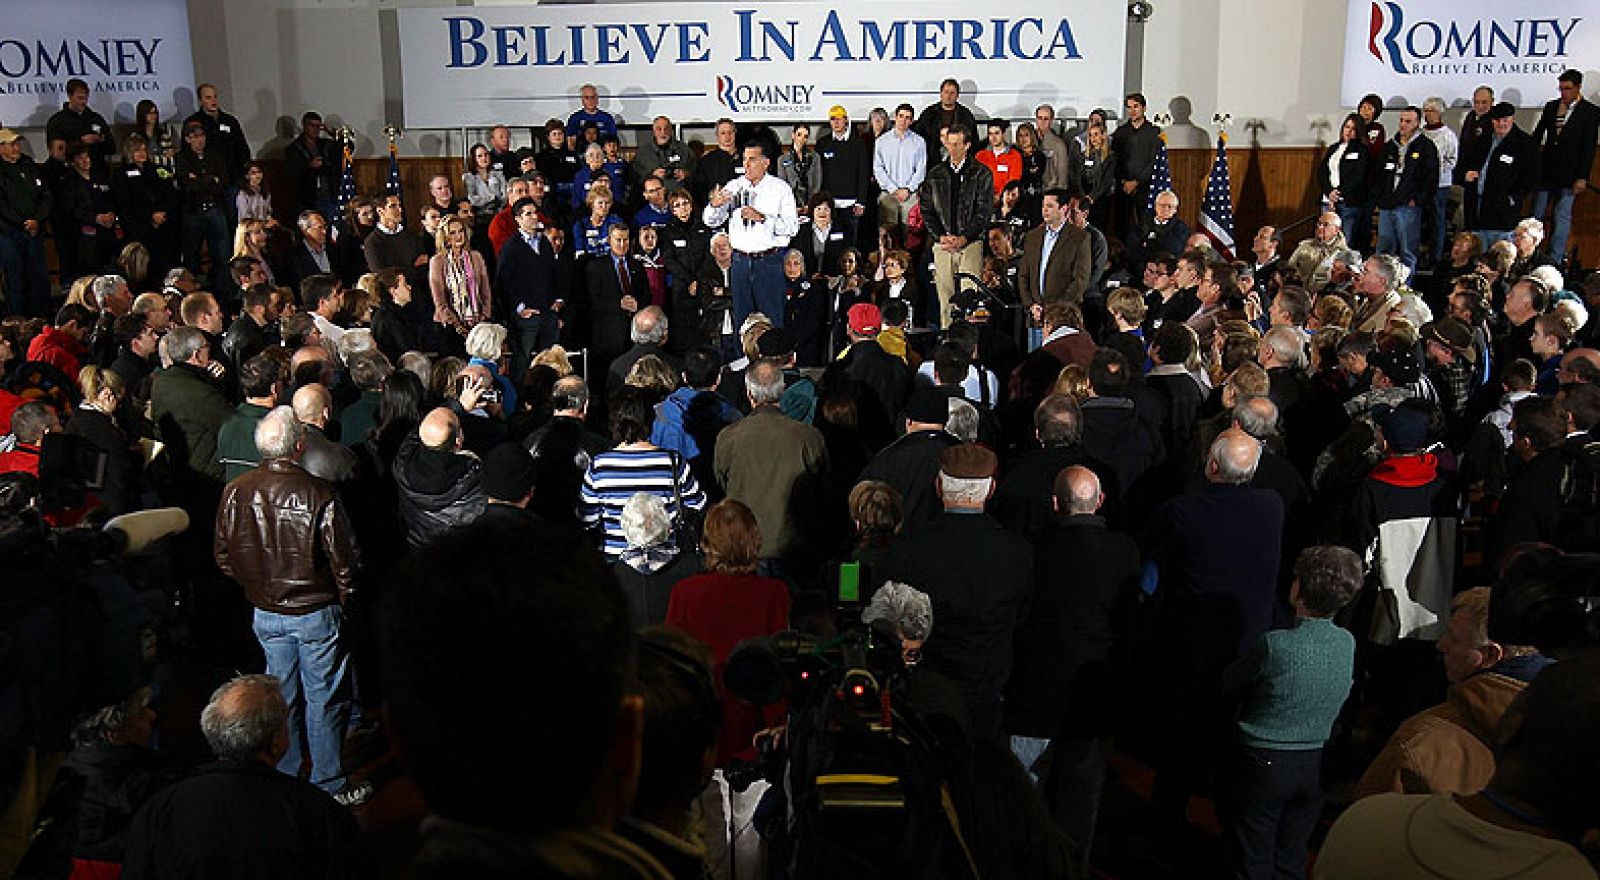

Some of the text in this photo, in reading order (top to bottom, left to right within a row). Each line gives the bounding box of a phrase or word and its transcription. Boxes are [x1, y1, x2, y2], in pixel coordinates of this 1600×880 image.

[441, 9, 1084, 69] BELIEVE IN AMERICA
[1369, 1, 1583, 74] ROMNEY
[0, 38, 162, 78] OMNEY
[1412, 62, 1567, 75] BELIEVE IN AMERICA
[95, 81, 160, 93] AMERICA
[716, 74, 815, 112] ROMNEY
